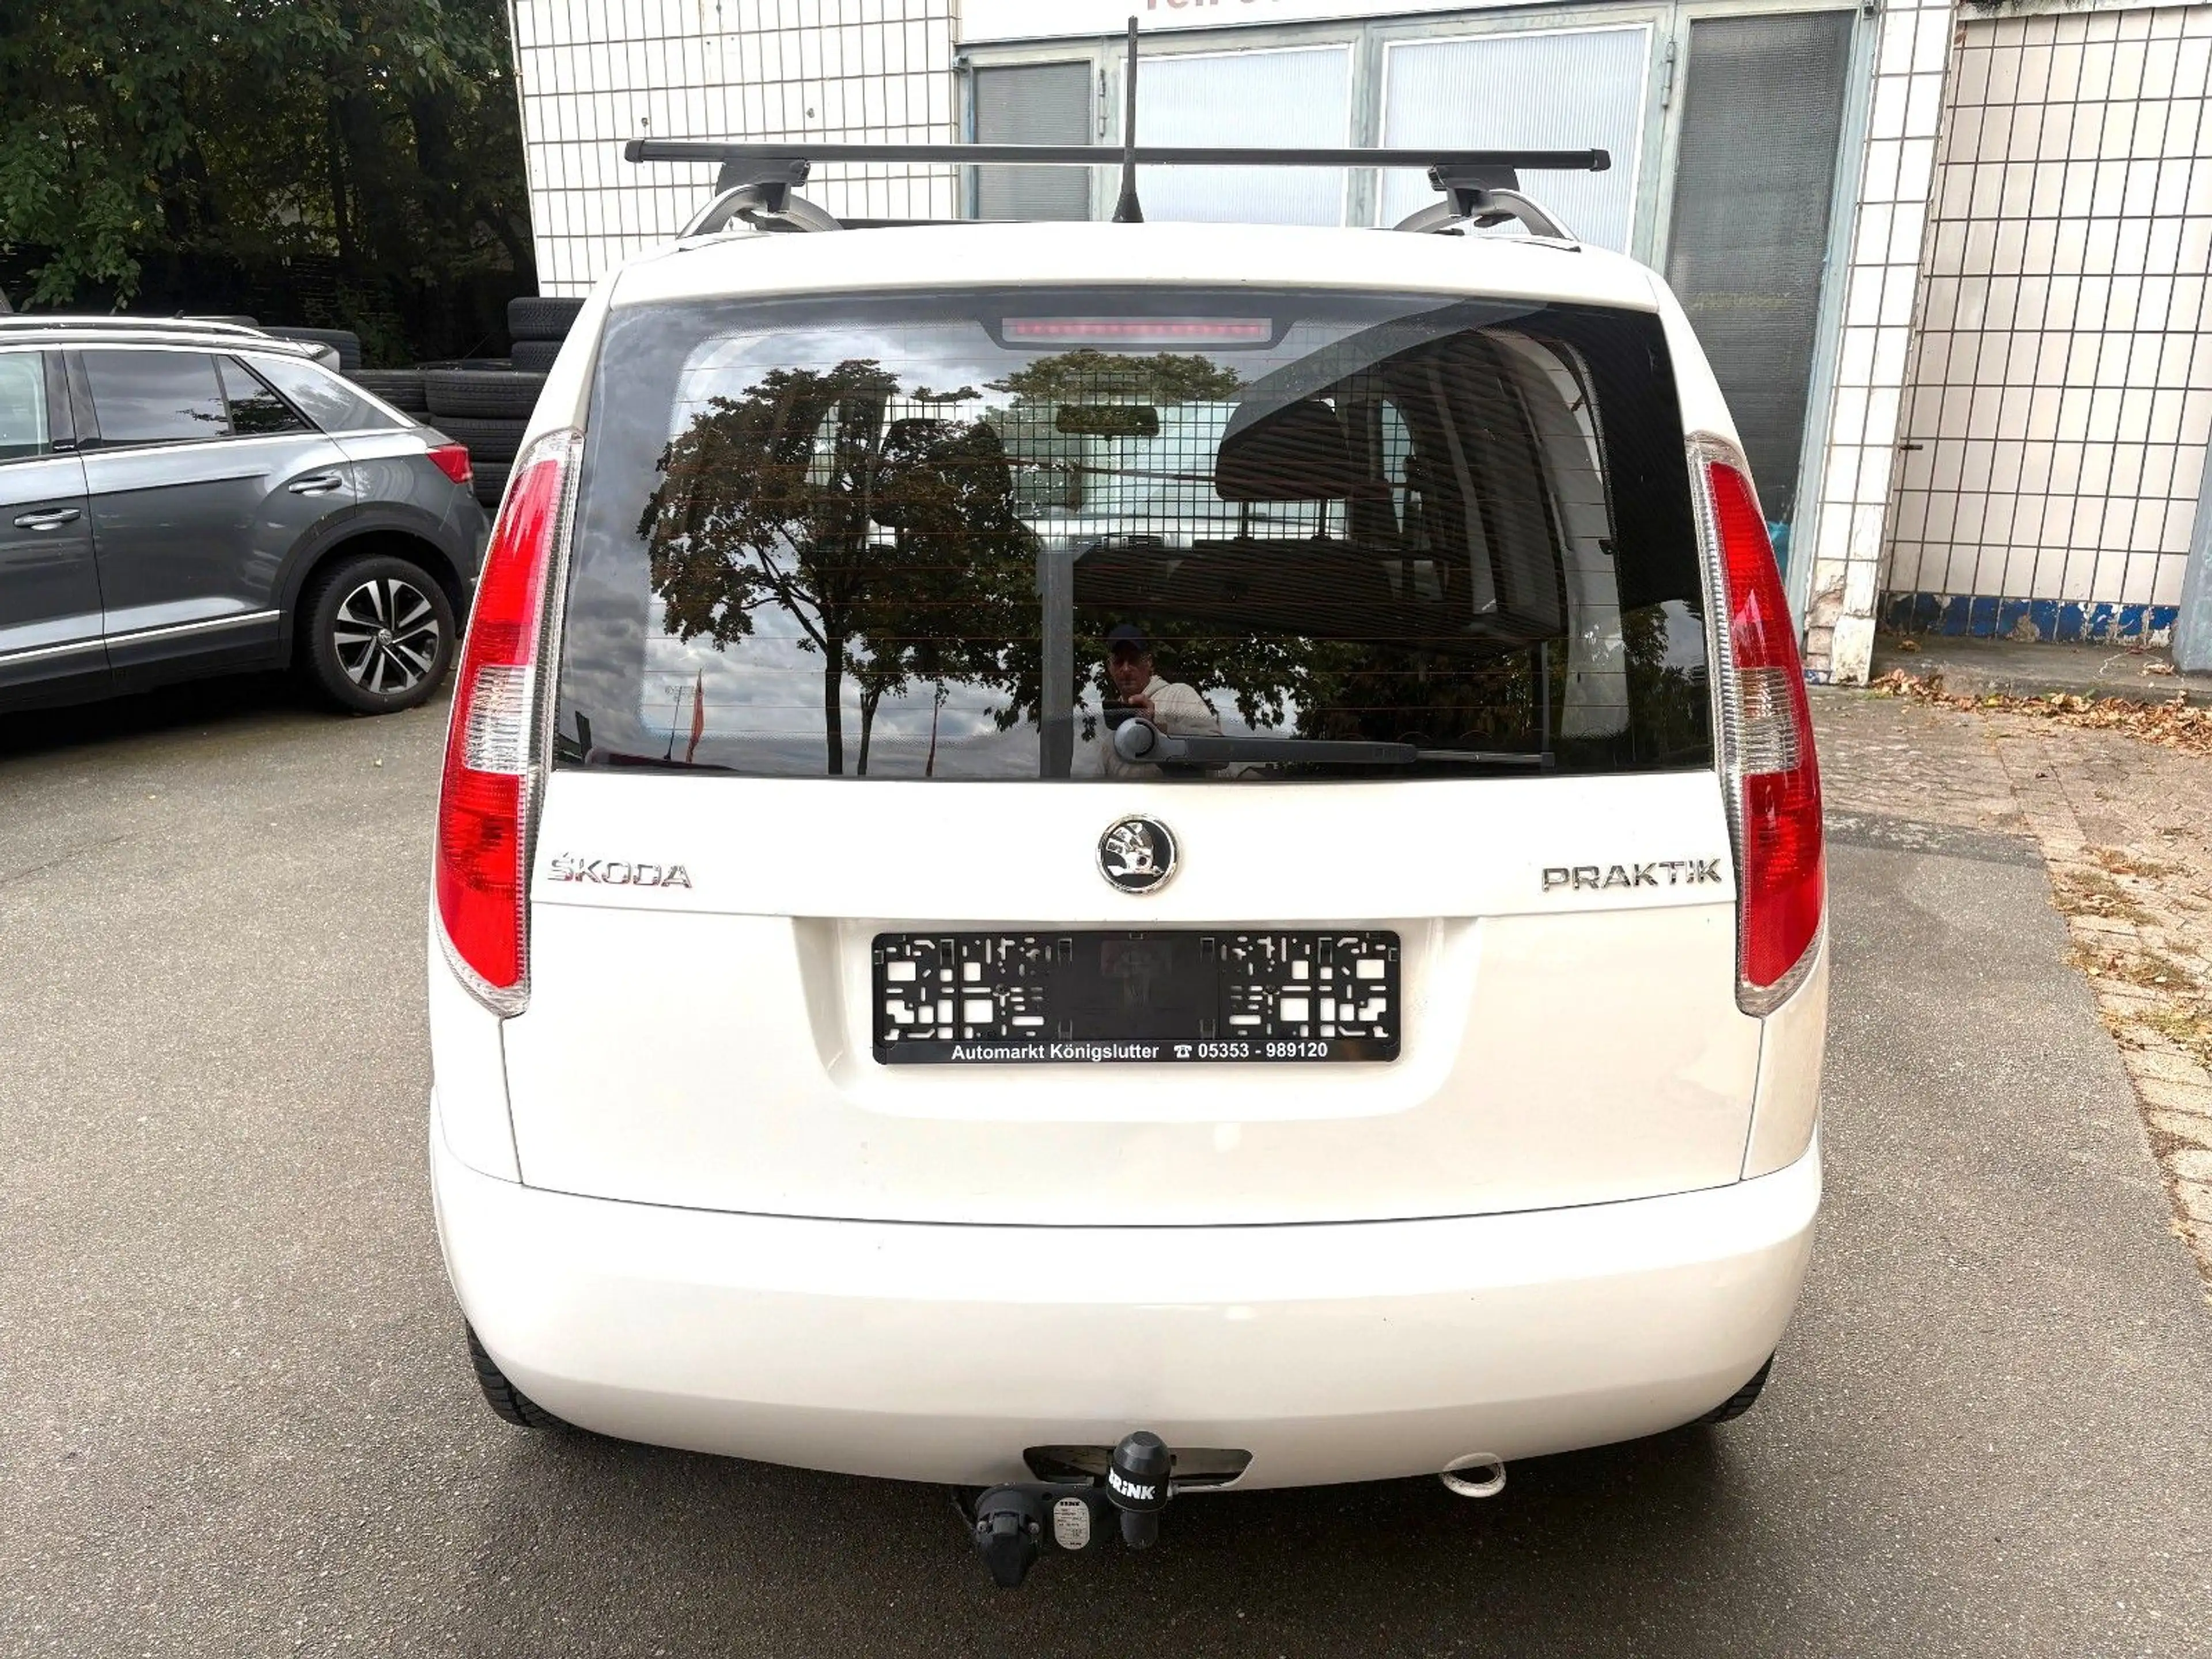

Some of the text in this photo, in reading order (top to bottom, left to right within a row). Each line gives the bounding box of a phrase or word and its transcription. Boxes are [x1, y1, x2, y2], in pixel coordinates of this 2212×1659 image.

[1541, 858, 1722, 892] PRAKTIK
[952, 1044, 1044, 1060] Automarkt
[1050, 1043, 1160, 1062] Königslutter
[1198, 1043, 1249, 1058] 05353
[1266, 1042, 1328, 1058] 989120
